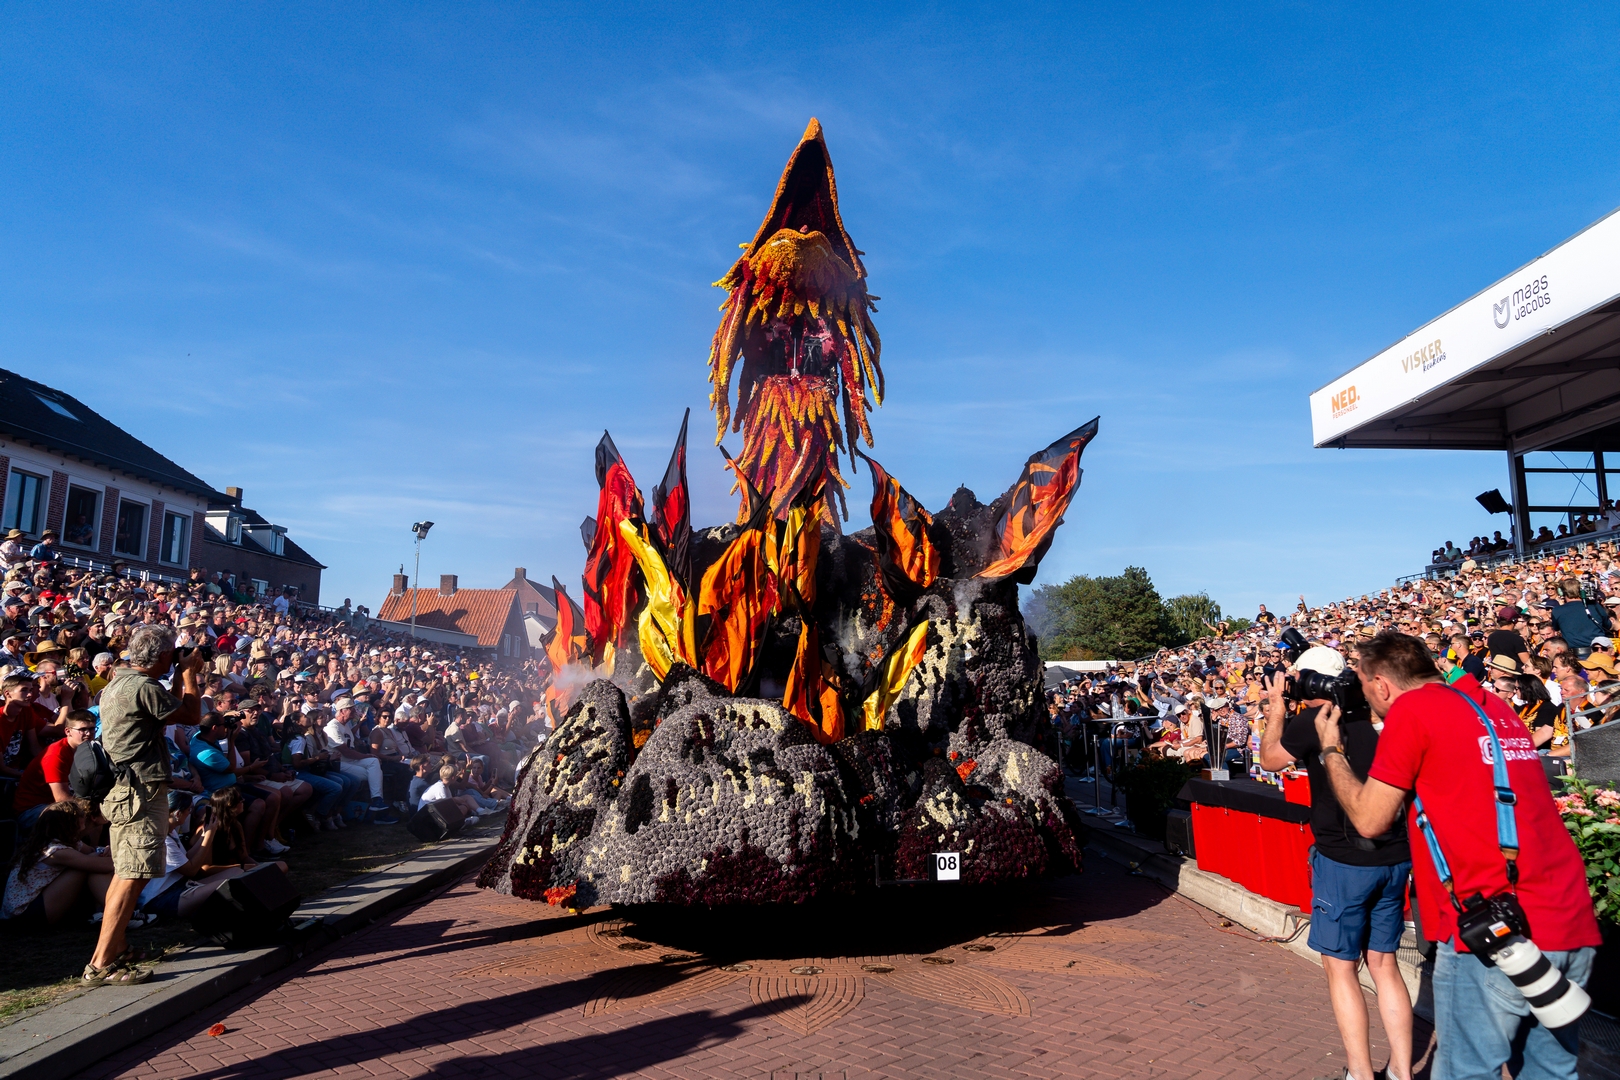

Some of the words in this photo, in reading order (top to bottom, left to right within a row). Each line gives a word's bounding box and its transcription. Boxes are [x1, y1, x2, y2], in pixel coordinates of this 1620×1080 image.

[1512, 274, 1548, 307] maas
[1401, 338, 1443, 374] VISKER
[1422, 352, 1447, 374] keukens
[1331, 385, 1361, 413] NED.
[1503, 749, 1538, 761] BRABANT
[938, 856, 957, 870] 08
